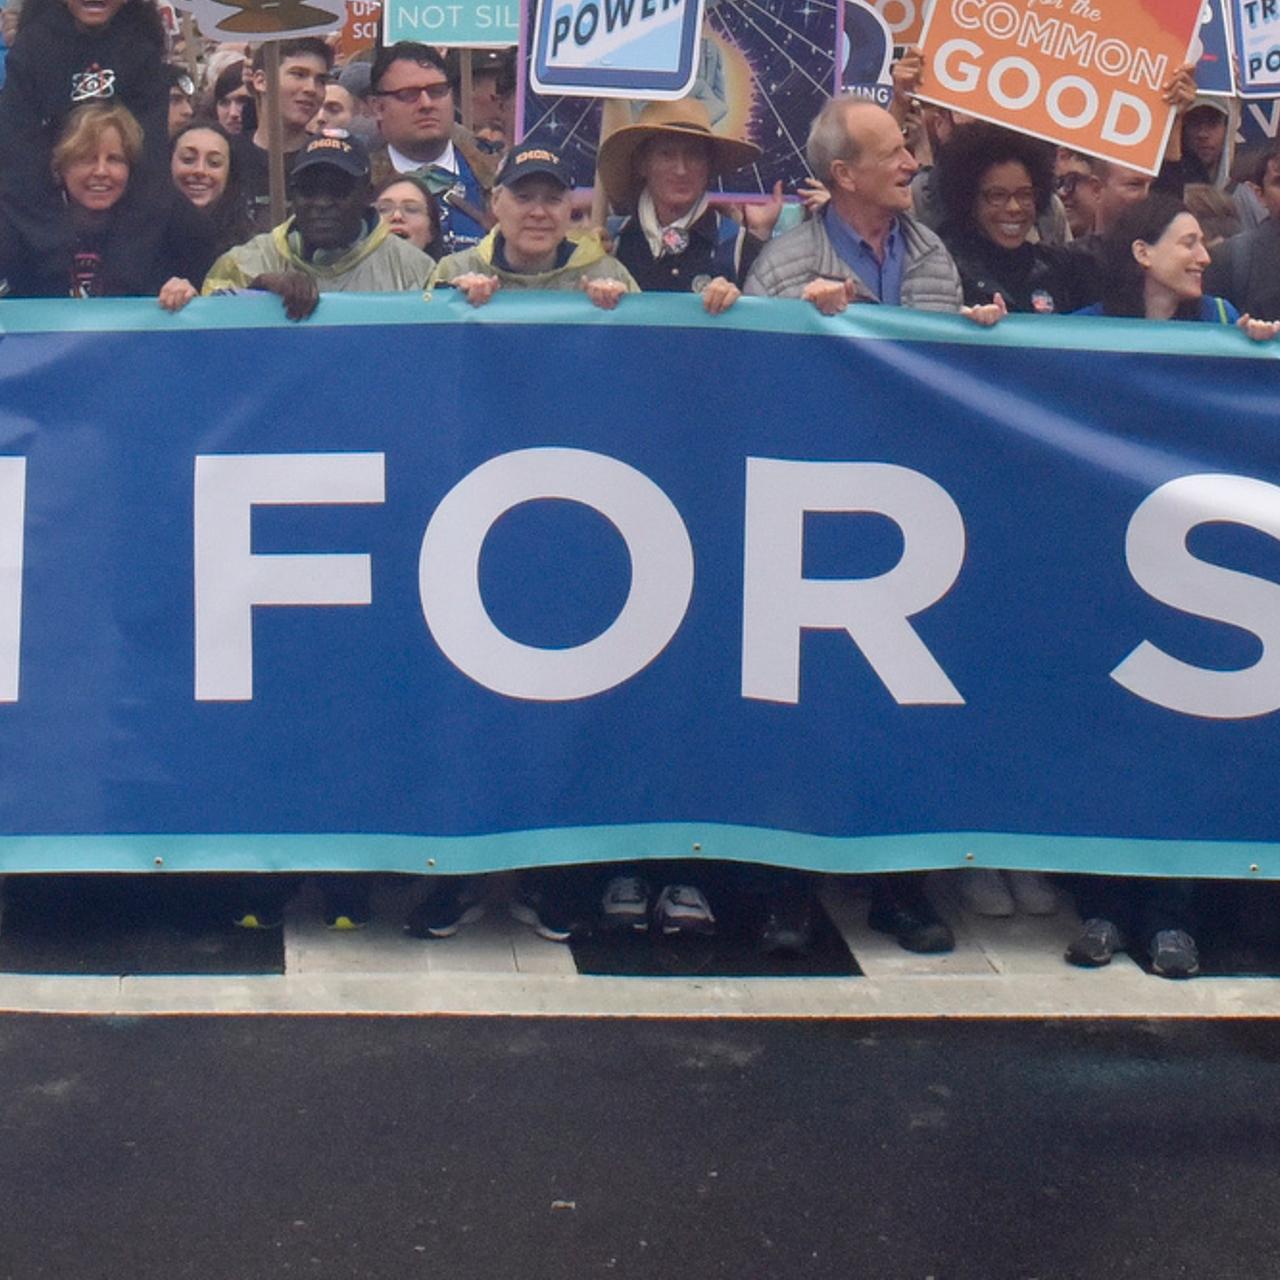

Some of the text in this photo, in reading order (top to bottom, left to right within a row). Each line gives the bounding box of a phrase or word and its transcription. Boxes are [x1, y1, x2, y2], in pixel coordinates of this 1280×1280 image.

[398, 6, 463, 29] NOT
[933, 39, 1152, 146] GOOD
[193, 446, 967, 706] FOR
